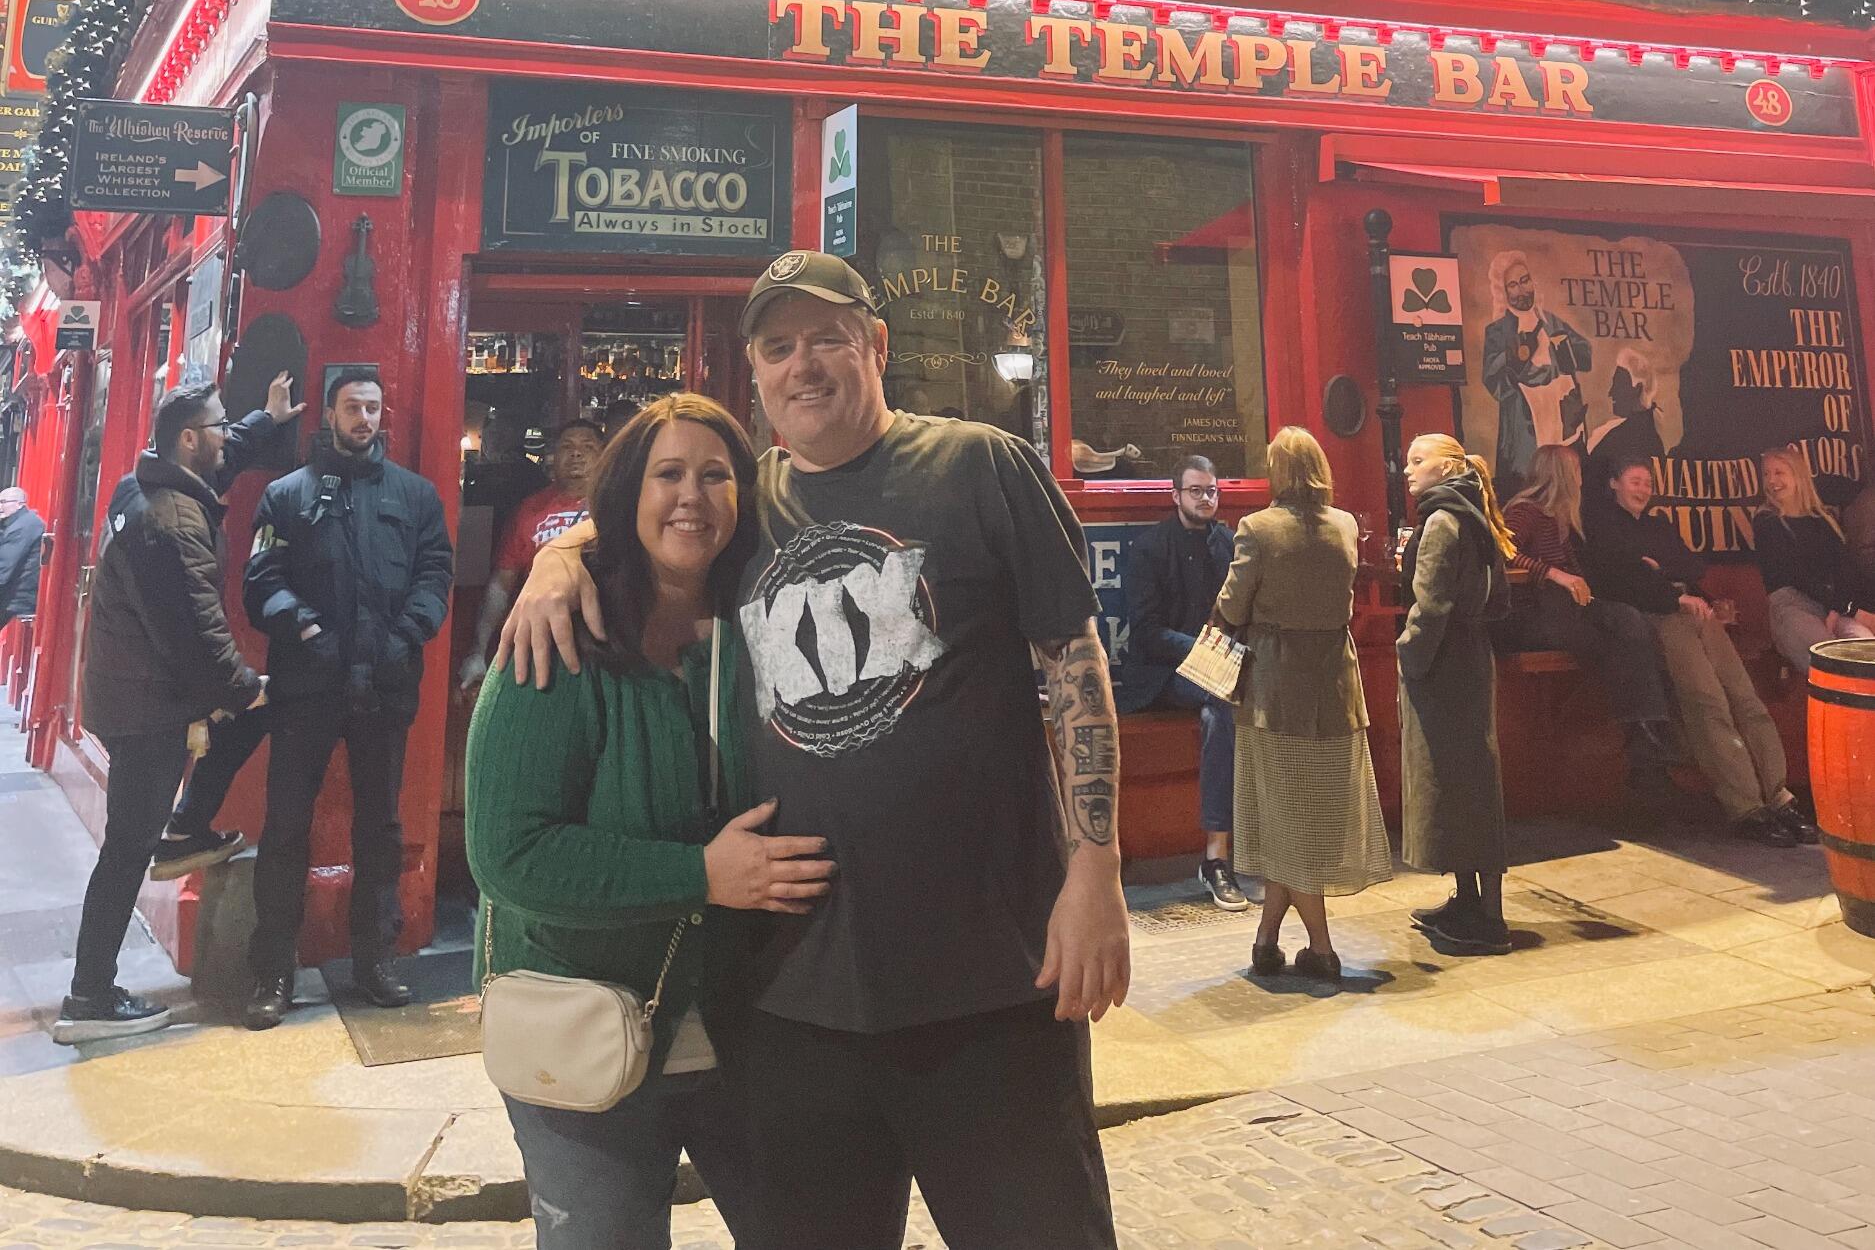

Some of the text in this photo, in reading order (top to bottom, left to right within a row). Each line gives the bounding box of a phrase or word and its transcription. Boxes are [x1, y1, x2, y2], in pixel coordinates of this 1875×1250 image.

[1026, 15, 1392, 101] TEMPLE
[1428, 51, 1594, 116] BAR
[1752, 87, 1781, 115] 48
[86, 115, 229, 145] The Whiskey Reserve
[502, 103, 624, 149] Importers
[580, 131, 600, 144] OF
[610, 142, 746, 165] FINE SMOKING
[345, 176, 391, 187] Member
[349, 166, 388, 177] Official
[534, 150, 748, 223] TOBACCO
[577, 212, 763, 236] Always in Stock
[921, 234, 962, 253] THE
[1587, 249, 1646, 279] THE
[1560, 278, 1675, 310] TEMPLE
[1800, 264, 1841, 299] 1840
[869, 267, 968, 313] EMPLE
[980, 277, 1036, 336] BAR
[941, 310, 965, 320] 1840
[1402, 331, 1422, 341] Teach
[1593, 310, 1654, 341] BAR
[1790, 308, 1845, 348] THE
[1423, 343, 1437, 352] Pub
[1136, 361, 1169, 377] lived
[1170, 363, 1197, 378] and
[1197, 363, 1233, 378] loved
[1729, 349, 1852, 390] EMPEROR
[1096, 385, 1124, 400] and
[1123, 386, 1177, 405] laughed
[1178, 387, 1205, 401] and
[1184, 418, 1239, 428] JAMES JOYCE
[1823, 394, 1852, 433] OF
[1651, 456, 1759, 499] MALTED
